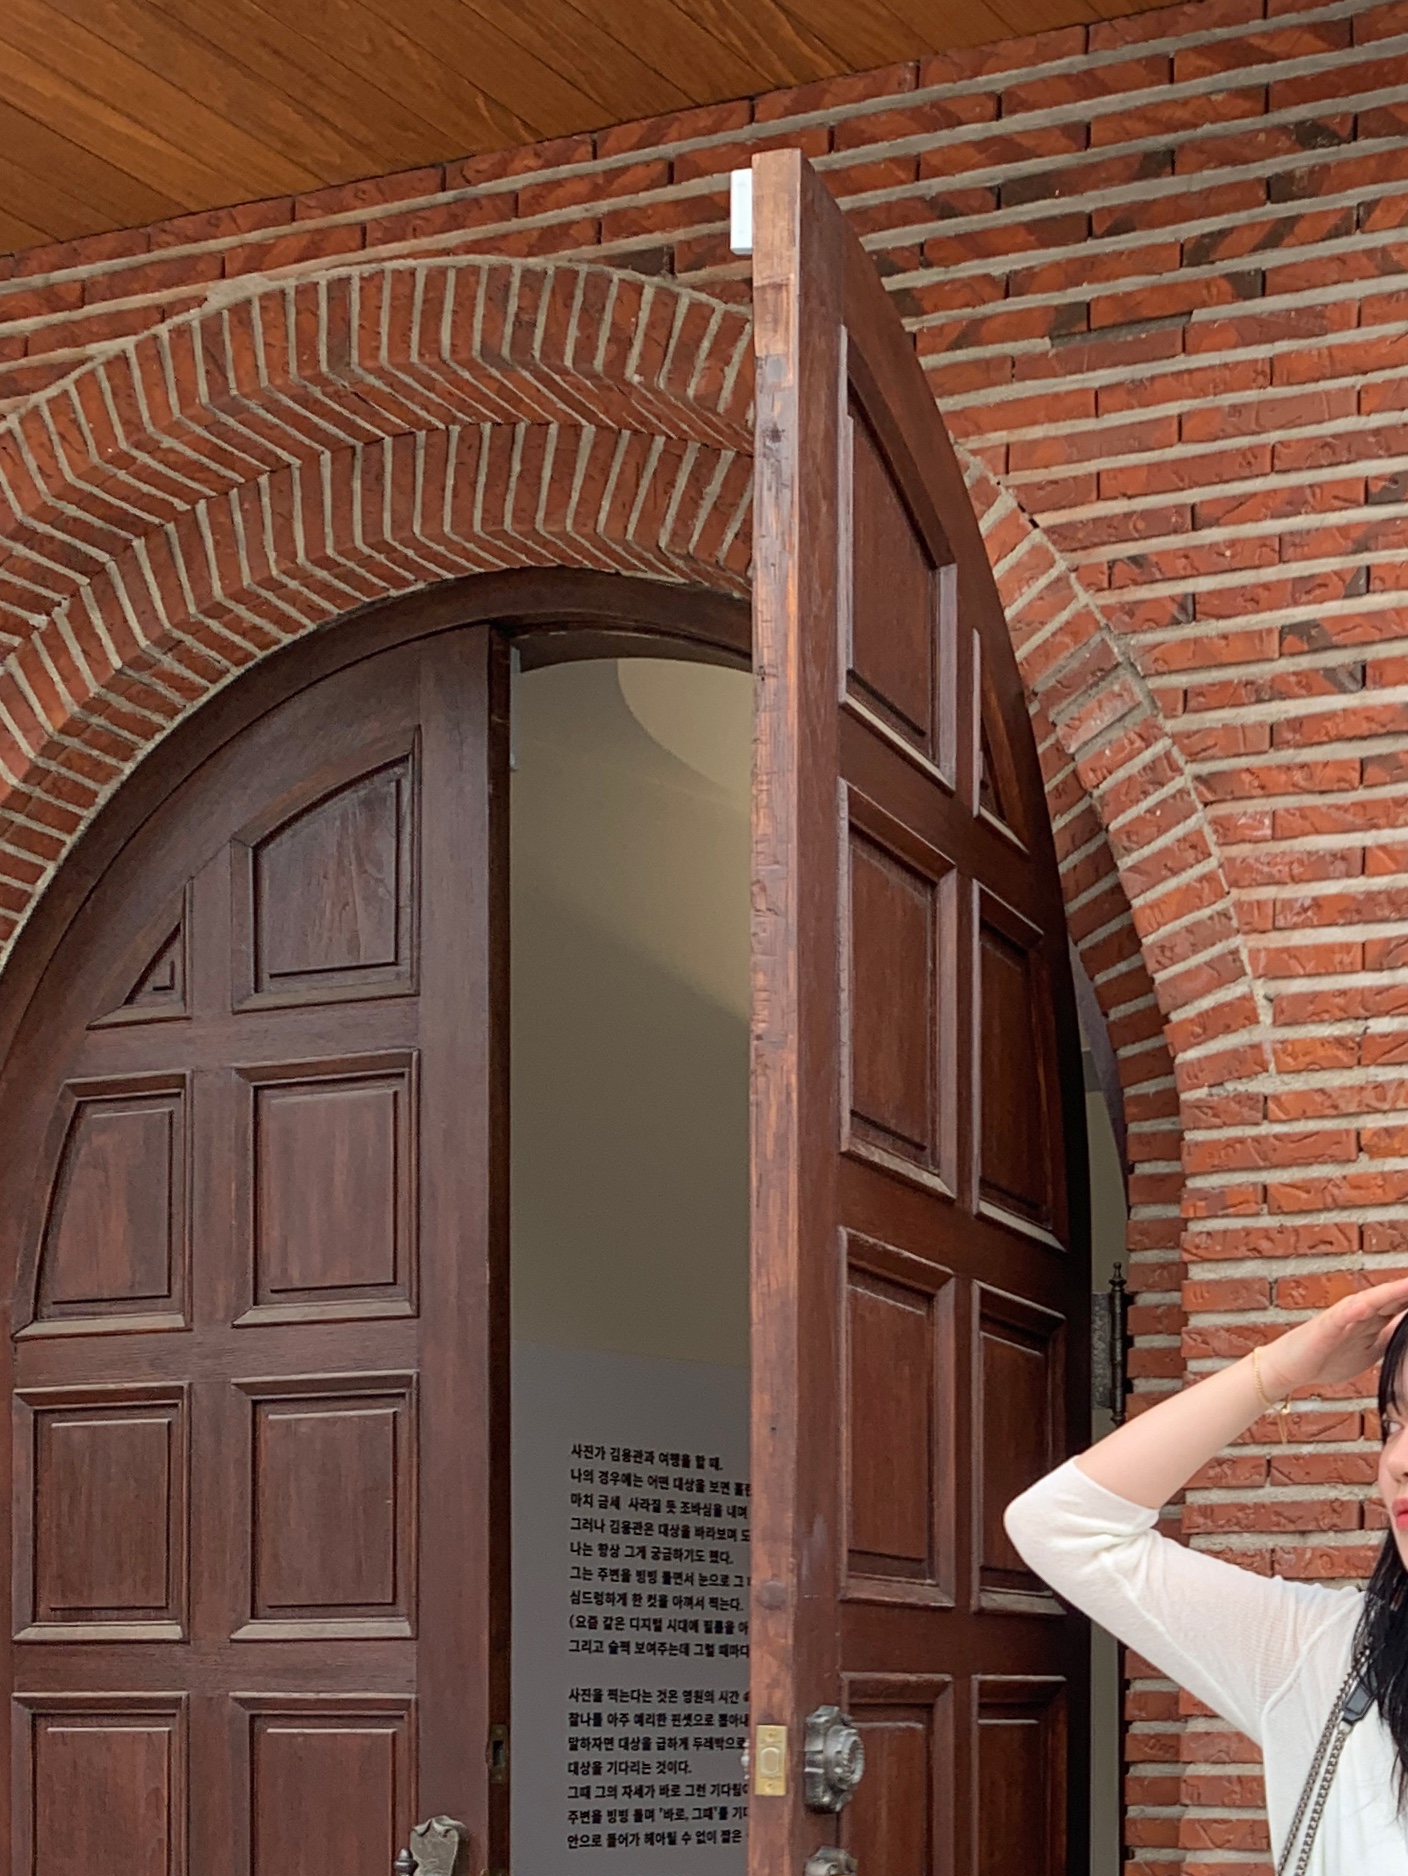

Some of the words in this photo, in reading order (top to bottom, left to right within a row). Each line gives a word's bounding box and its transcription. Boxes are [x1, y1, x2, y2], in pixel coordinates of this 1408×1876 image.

[571, 1444, 606, 1460] 사진가
[610, 1447, 655, 1465] 김용관과
[659, 1452, 691, 1468] 여행을
[695, 1455, 706, 1470] 할
[571, 1468, 594, 1484] 나의
[598, 1471, 643, 1488] 경우에는
[647, 1475, 669, 1490] 어떤
[673, 1477, 705, 1493] 대상을
[709, 1481, 730, 1495] 보면
[571, 1493, 593, 1508] 마치
[598, 1495, 621, 1510] 금세
[628, 1497, 661, 1513] 사라질
[666, 1500, 677, 1514] 듯
[680, 1501, 722, 1518] 조바심을
[727, 1505, 748, 1519] 내며
[570, 1518, 606, 1533] 그러나
[610, 1520, 654, 1536] 김용관은
[658, 1523, 690, 1539] 대상을
[694, 1526, 737, 1542] 바라보며
[570, 1541, 593, 1556] 나는
[597, 1543, 620, 1558] 항상
[624, 1545, 646, 1560] 그게
[651, 1546, 705, 1563] 궁금하기도
[709, 1550, 733, 1565] 했다.
[570, 1566, 593, 1581] 그는
[598, 1567, 632, 1583] 주변을
[636, 1570, 657, 1585] 빙빙
[662, 1571, 694, 1586] 돌면서
[698, 1573, 730, 1587] 눈으로
[733, 1575, 744, 1587] 그
[570, 1590, 628, 1607] 심드렁하게
[632, 1593, 643, 1607] 한
[647, 1594, 668, 1608] 컷을
[708, 1597, 744, 1611] 찍는다.
[603, 1616, 625, 1631] 같은
[630, 1617, 662, 1632] 디지털
[667, 1618, 699, 1633] 시대에
[569, 1639, 604, 1654] 그리고
[634, 1641, 690, 1657] 보여주는데
[694, 1643, 715, 1657] 그럴
[568, 1687, 604, 1703] 사진을
[607, 1688, 653, 1703] 찍는다는
[657, 1689, 678, 1704] 것은
[682, 1690, 715, 1704] 영원의
[718, 1690, 739, 1704] 시간
[569, 1712, 603, 1727] 찰나를
[607, 1712, 630, 1727] 아주
[634, 1713, 667, 1727] 예리한
[671, 1713, 715, 1727] 핀셋으로
[568, 1736, 614, 1751] 말하자면
[618, 1736, 652, 1751] 대상을
[656, 1736, 689, 1751] 급하게
[568, 1761, 603, 1776] 대상을
[607, 1760, 652, 1775] 기다리는
[656, 1760, 692, 1775] 것이다.
[567, 1785, 591, 1800] 그때
[594, 1785, 617, 1800] 그의
[622, 1784, 655, 1799] 자세가
[659, 1784, 681, 1798] 바로
[684, 1783, 706, 1797] 그런
[568, 1809, 602, 1825] 주변을
[607, 1809, 629, 1824] 빙빙
[633, 1808, 655, 1823] 돌며
[567, 1834, 602, 1849] 안으로
[606, 1832, 640, 1848] 들어가
[681, 1831, 691, 1845] 수
[695, 1830, 717, 1844] 없이
[720, 1829, 742, 1844] 짧은
